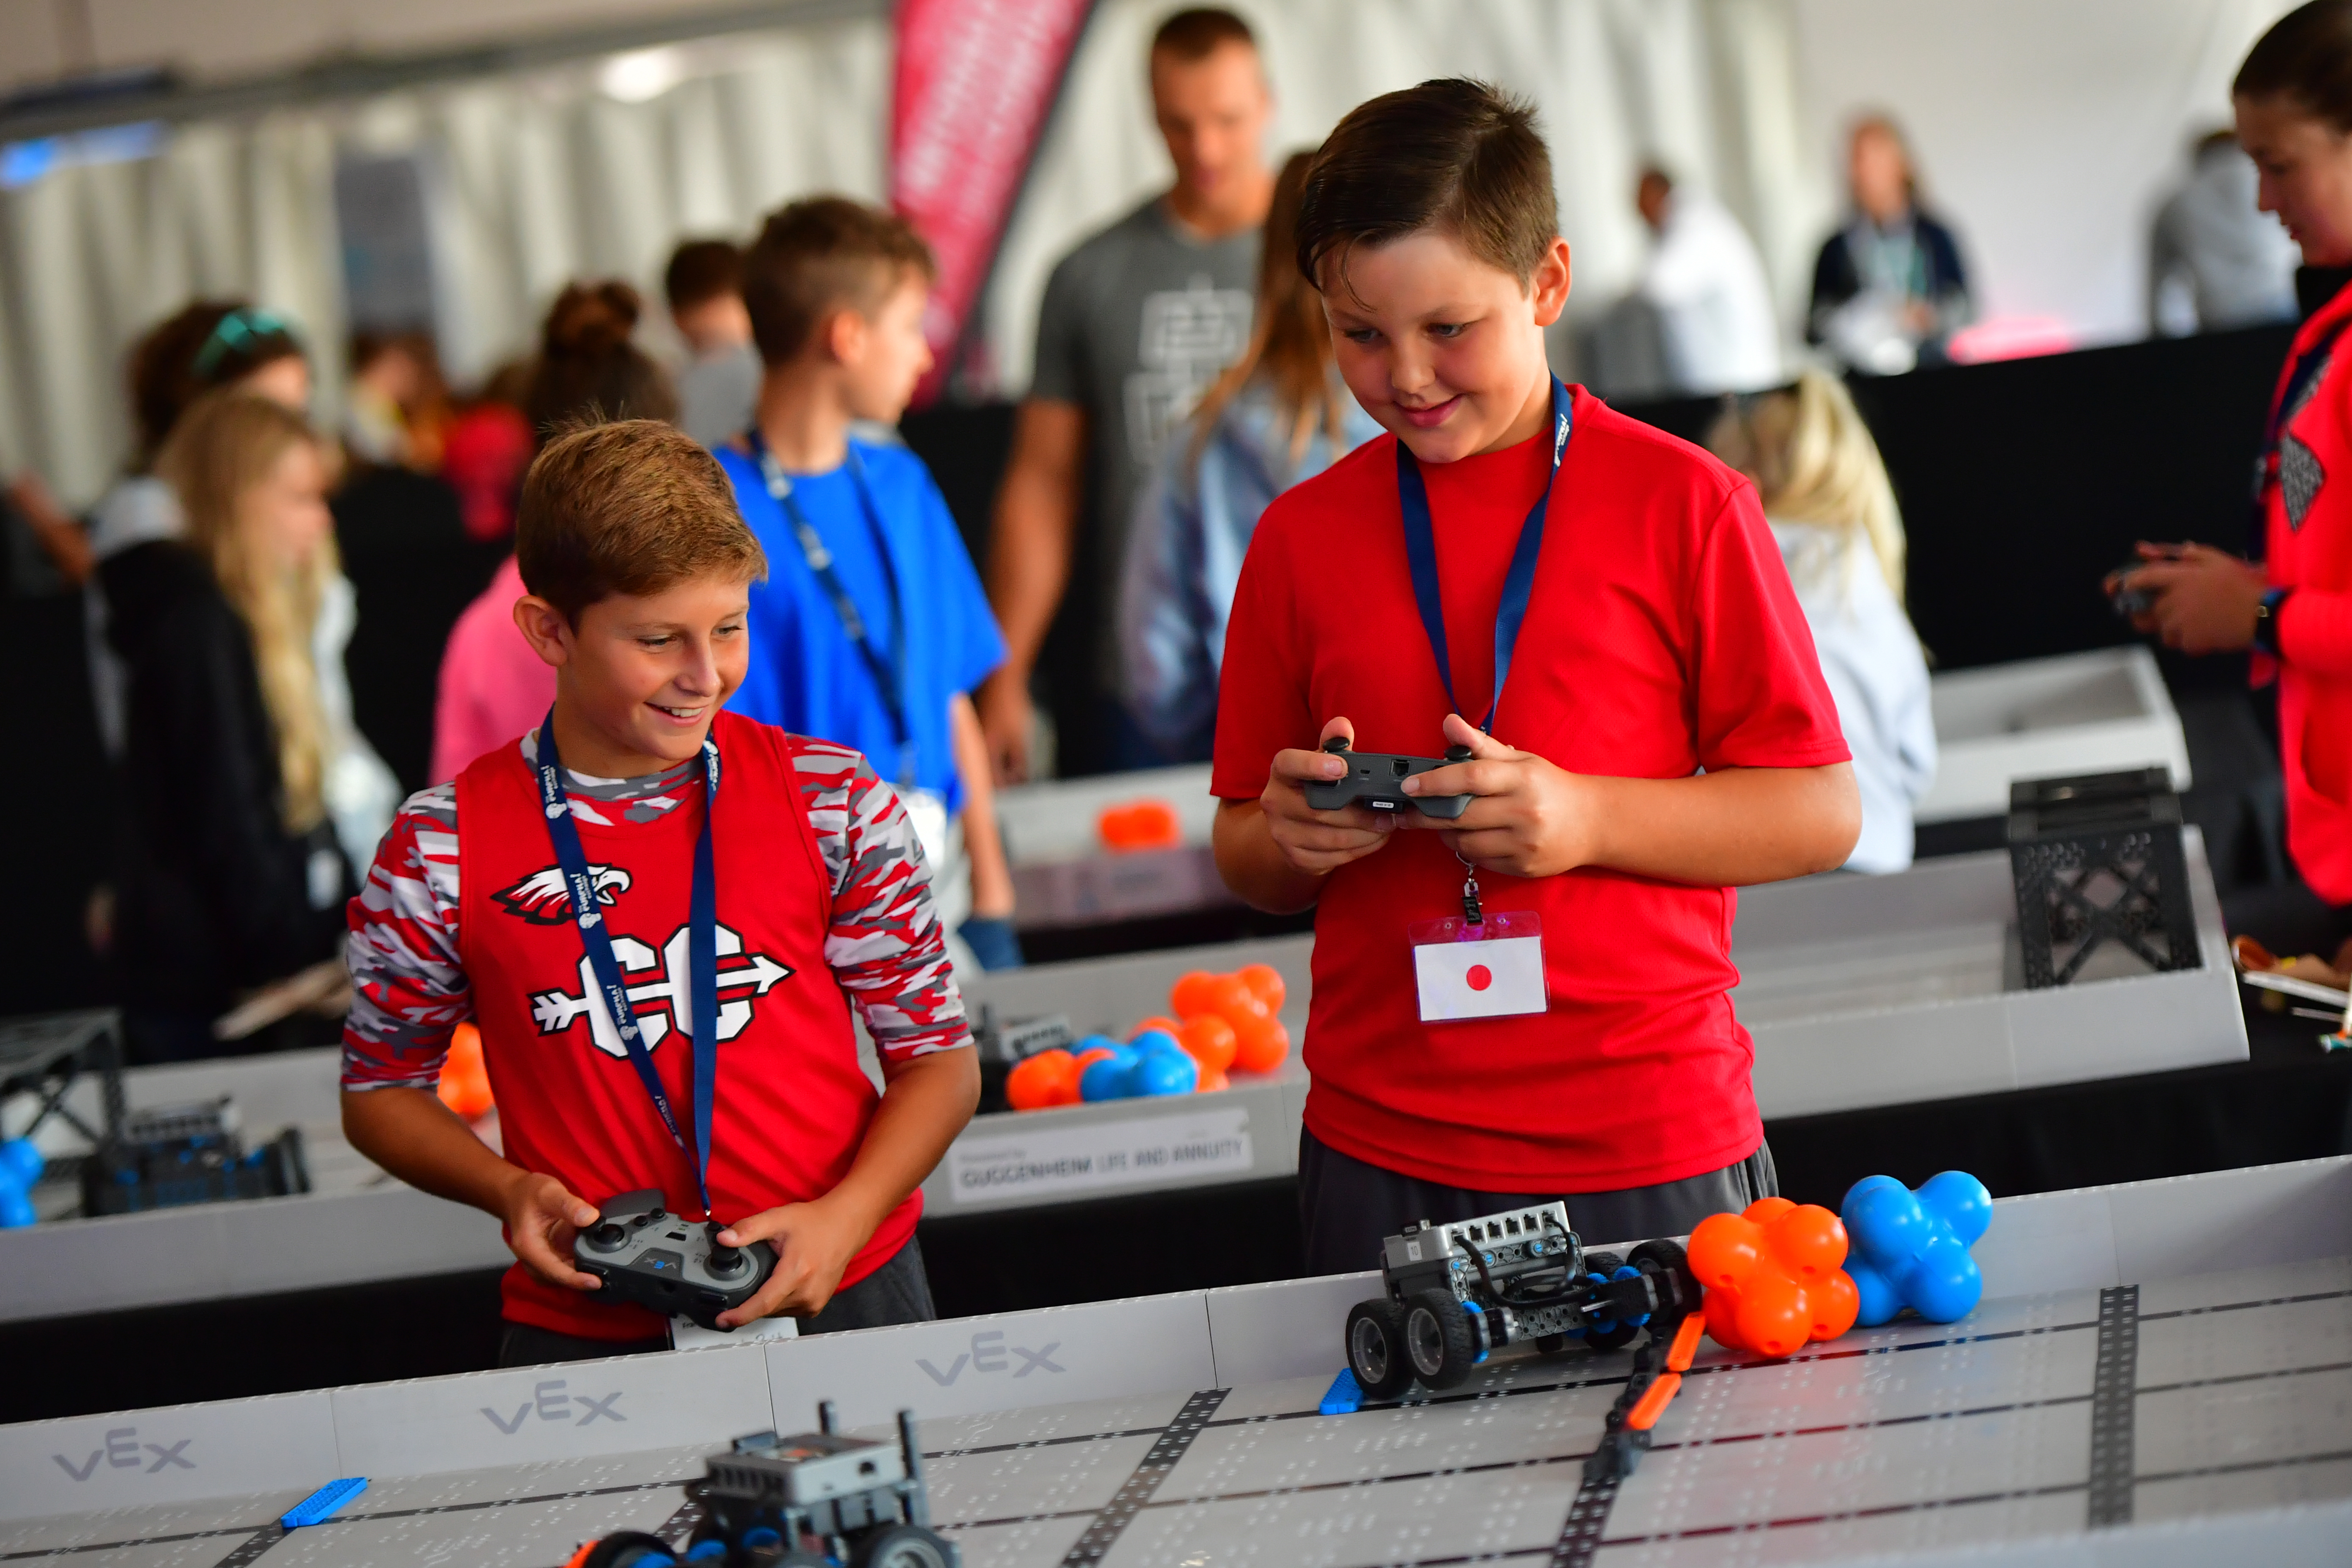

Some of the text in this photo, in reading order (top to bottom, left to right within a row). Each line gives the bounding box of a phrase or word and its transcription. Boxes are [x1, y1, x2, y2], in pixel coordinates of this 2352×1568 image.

[1135, 1146, 1168, 1167] AND
[1173, 1139, 1243, 1163] ANNUITY
[915, 1330, 1067, 1387] VEX
[480, 1380, 628, 1435] VEX
[51, 1427, 197, 1482] VEX
